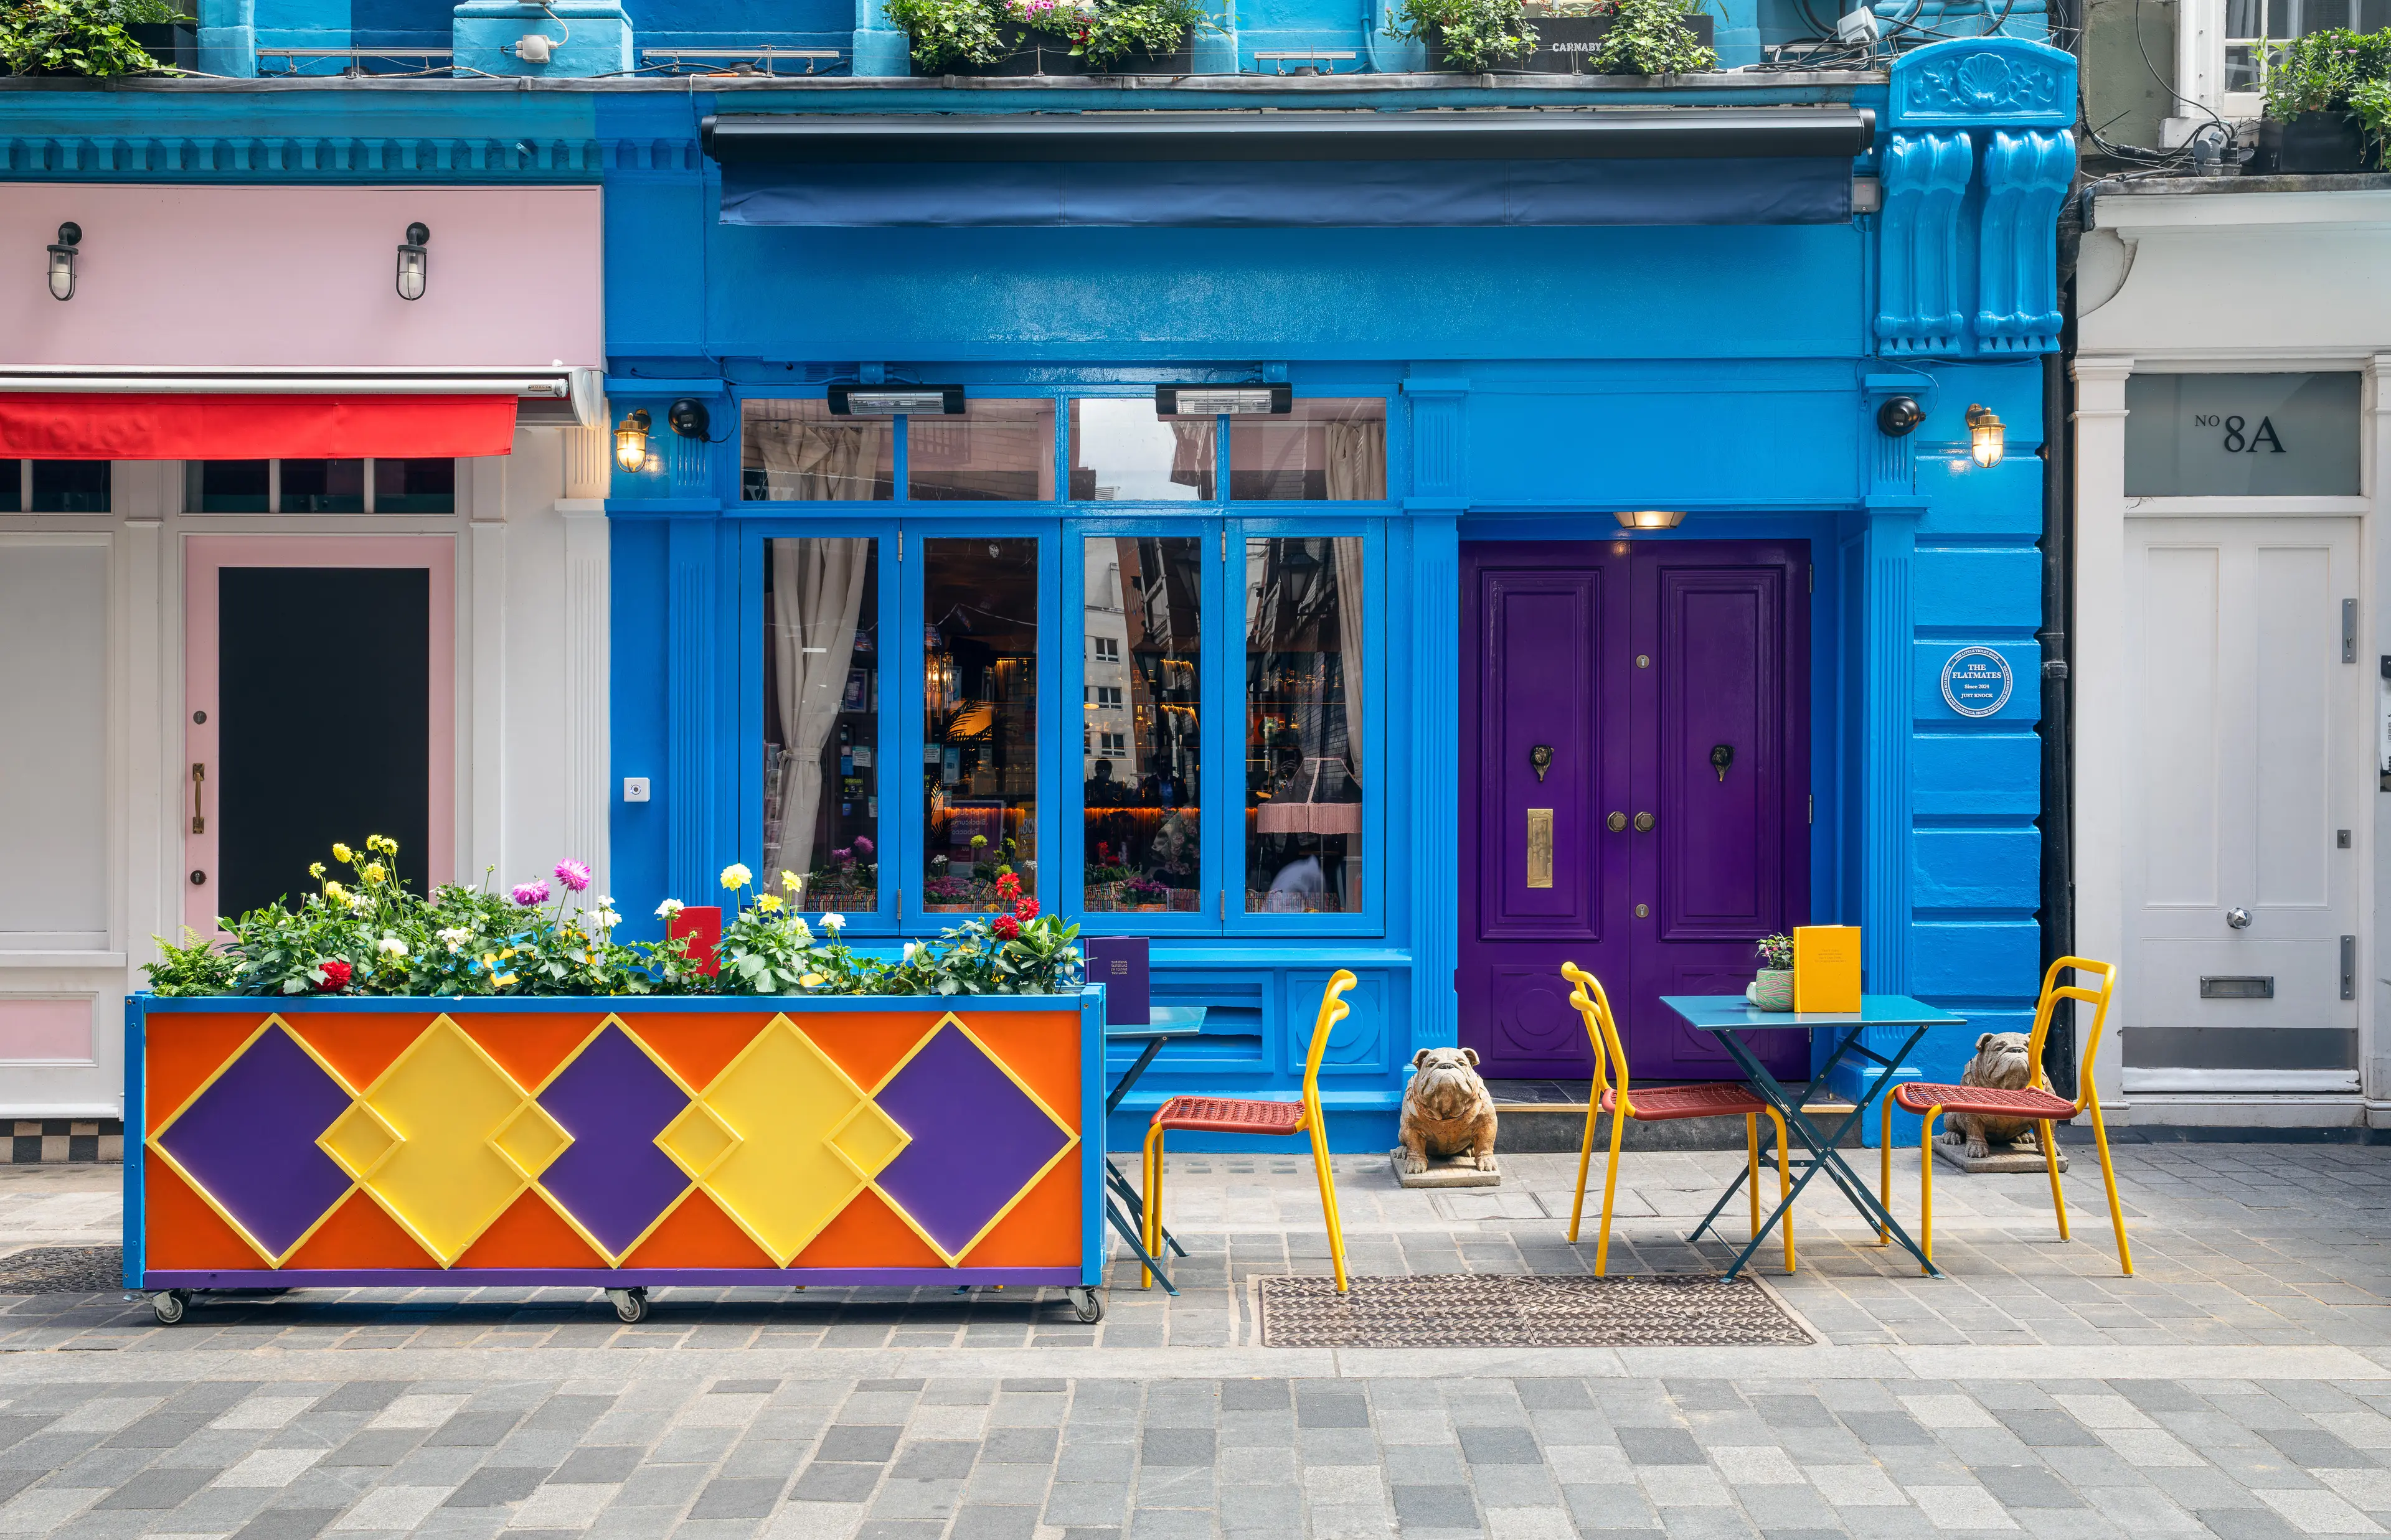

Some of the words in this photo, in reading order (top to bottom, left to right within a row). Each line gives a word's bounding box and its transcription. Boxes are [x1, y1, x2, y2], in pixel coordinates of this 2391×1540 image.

[1552, 42, 1601, 52] CARNABY
[2195, 415, 2220, 426] NO
[2224, 415, 2286, 453] 8A
[1989, 652, 1999, 660] DOOR
